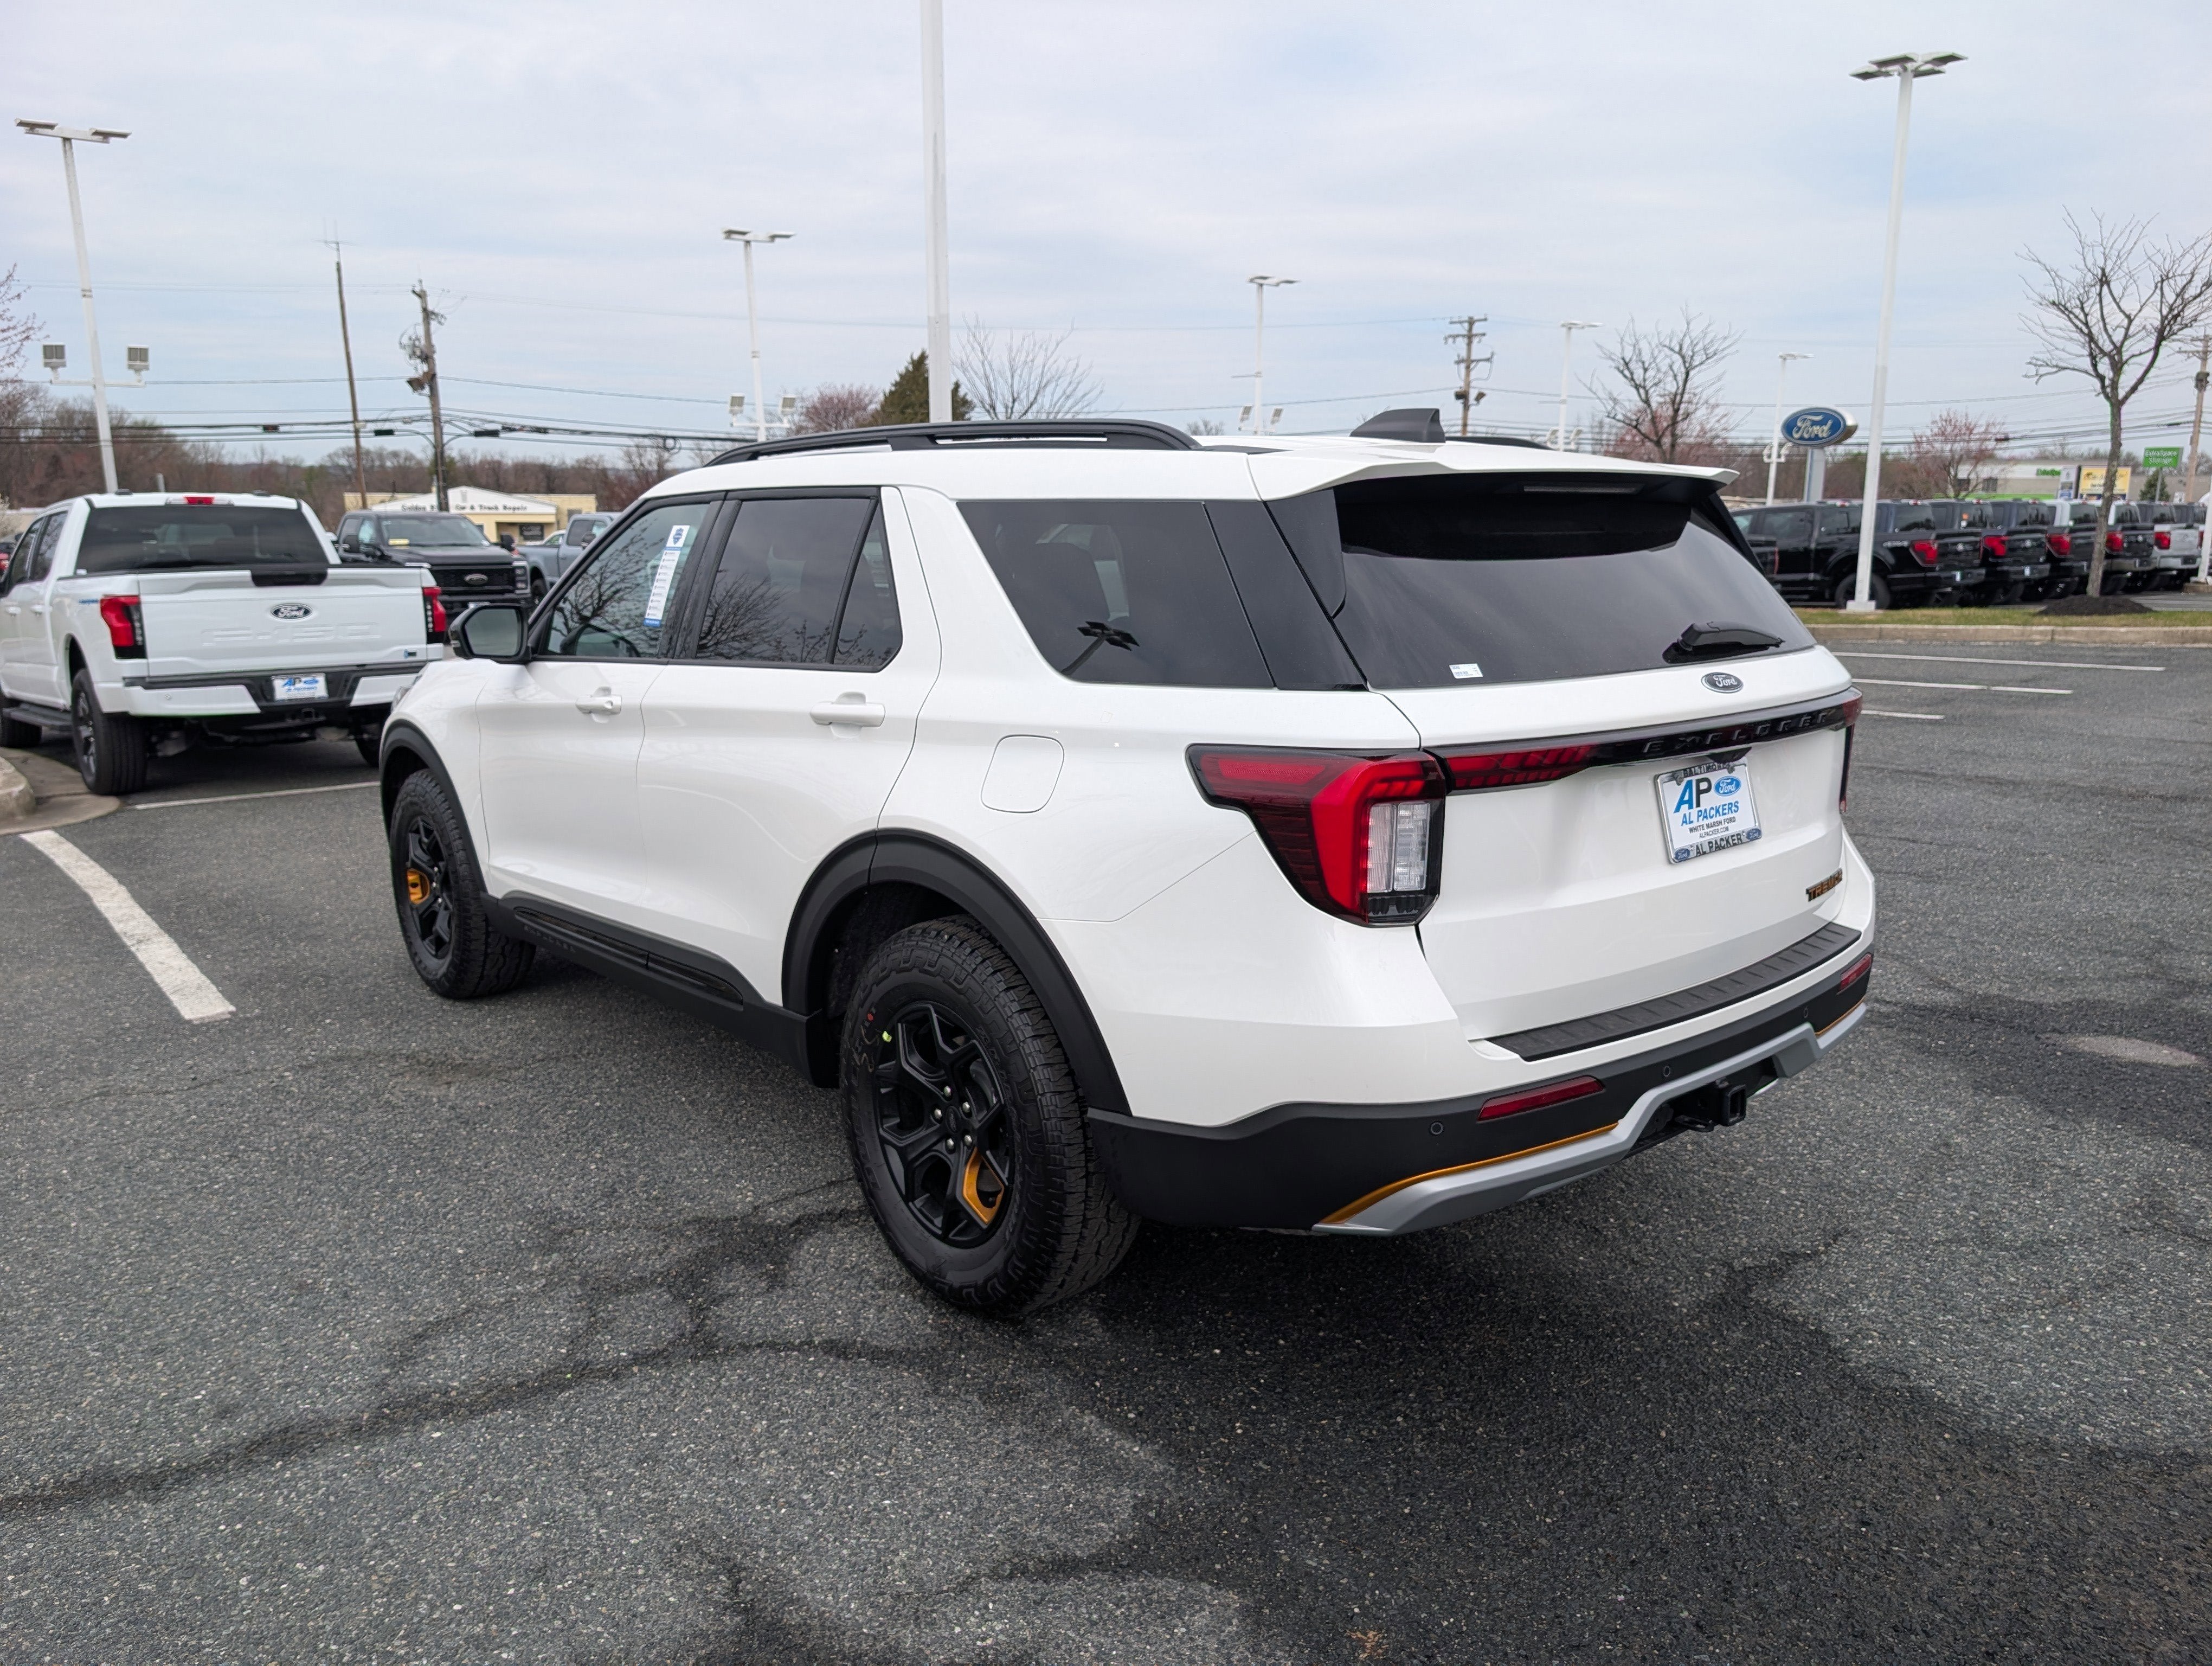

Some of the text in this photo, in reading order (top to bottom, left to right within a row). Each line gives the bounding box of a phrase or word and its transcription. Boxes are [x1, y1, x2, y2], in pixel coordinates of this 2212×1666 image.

[1792, 415, 1833, 439] Ford
[402, 503, 426, 512] Golden
[503, 503, 528, 513] Repair
[201, 622, 382, 646] F-150
[1713, 674, 1738, 687] Ford
[1643, 712, 1829, 753] EXPLORER
[1673, 777, 1737, 813] AP Ford
[1681, 800, 1739, 826] AL PACKERS
[1688, 816, 1736, 834] WHITE MARSH FORD
[1699, 826, 1729, 838] ALPACKER.COM
[1695, 833, 1743, 857] AL PACKER
